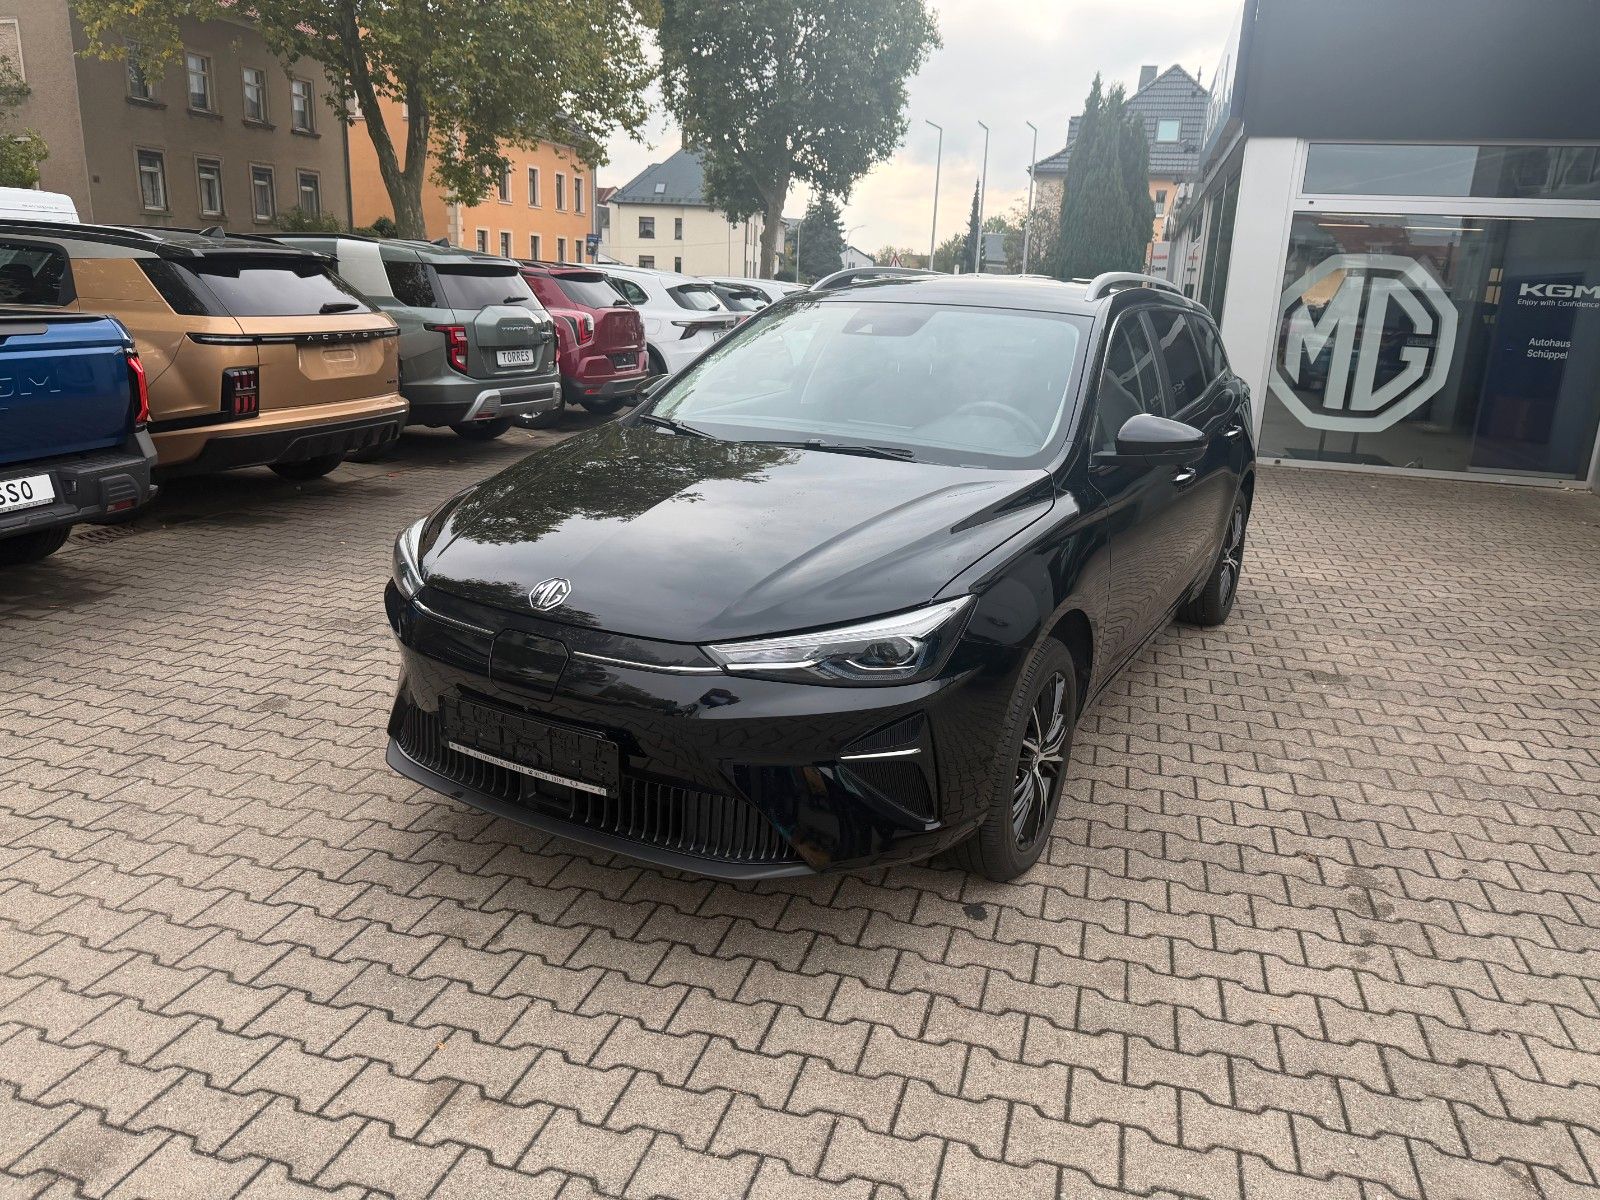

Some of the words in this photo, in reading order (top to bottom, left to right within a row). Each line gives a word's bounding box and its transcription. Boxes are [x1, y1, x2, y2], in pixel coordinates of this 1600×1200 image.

[1519, 283, 1600, 299] KGM
[1517, 299, 1539, 307] Enjoy
[1558, 300, 1600, 308] Confidence
[307, 331, 380, 341] ACTYON
[1283, 276, 1434, 411] MG
[1528, 338, 1571, 348] Autohaus
[502, 351, 530, 363] TORRES
[1527, 349, 1569, 360] Schüppel
[532, 580, 567, 607] MG
